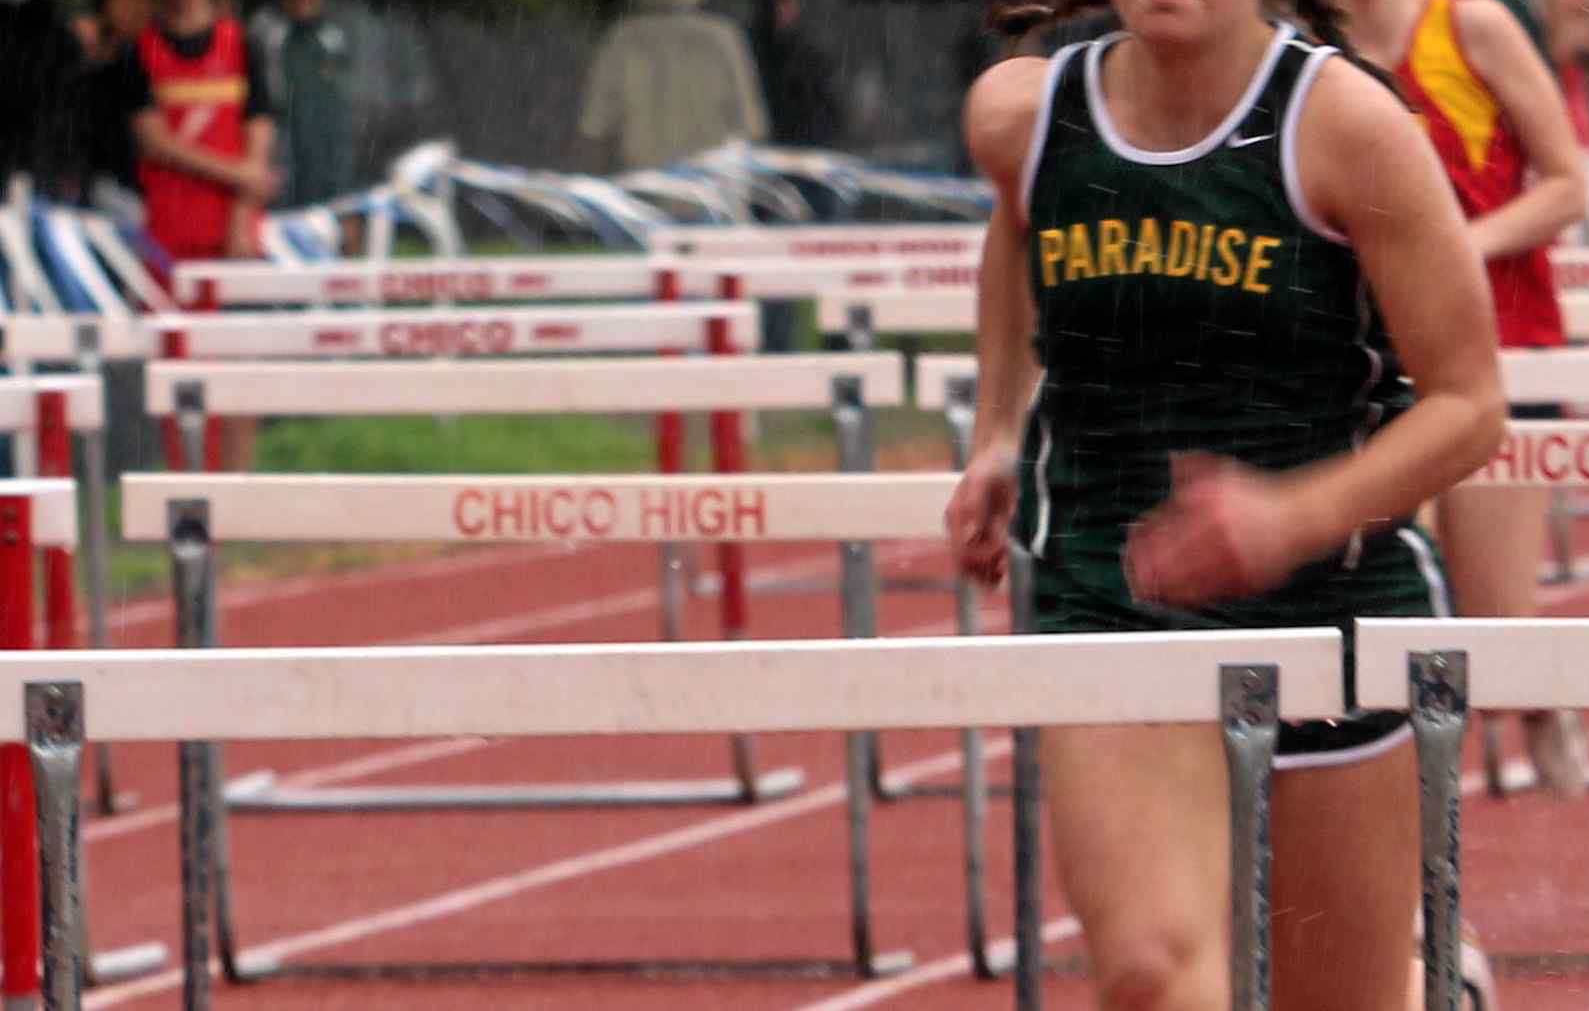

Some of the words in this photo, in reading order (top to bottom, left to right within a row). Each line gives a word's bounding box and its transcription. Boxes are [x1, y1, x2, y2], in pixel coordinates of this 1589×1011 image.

[1038, 217, 1281, 294] PARADISE
[380, 321, 515, 354] CHICO
[453, 488, 617, 537] CHICO
[638, 488, 767, 537] HIGH
